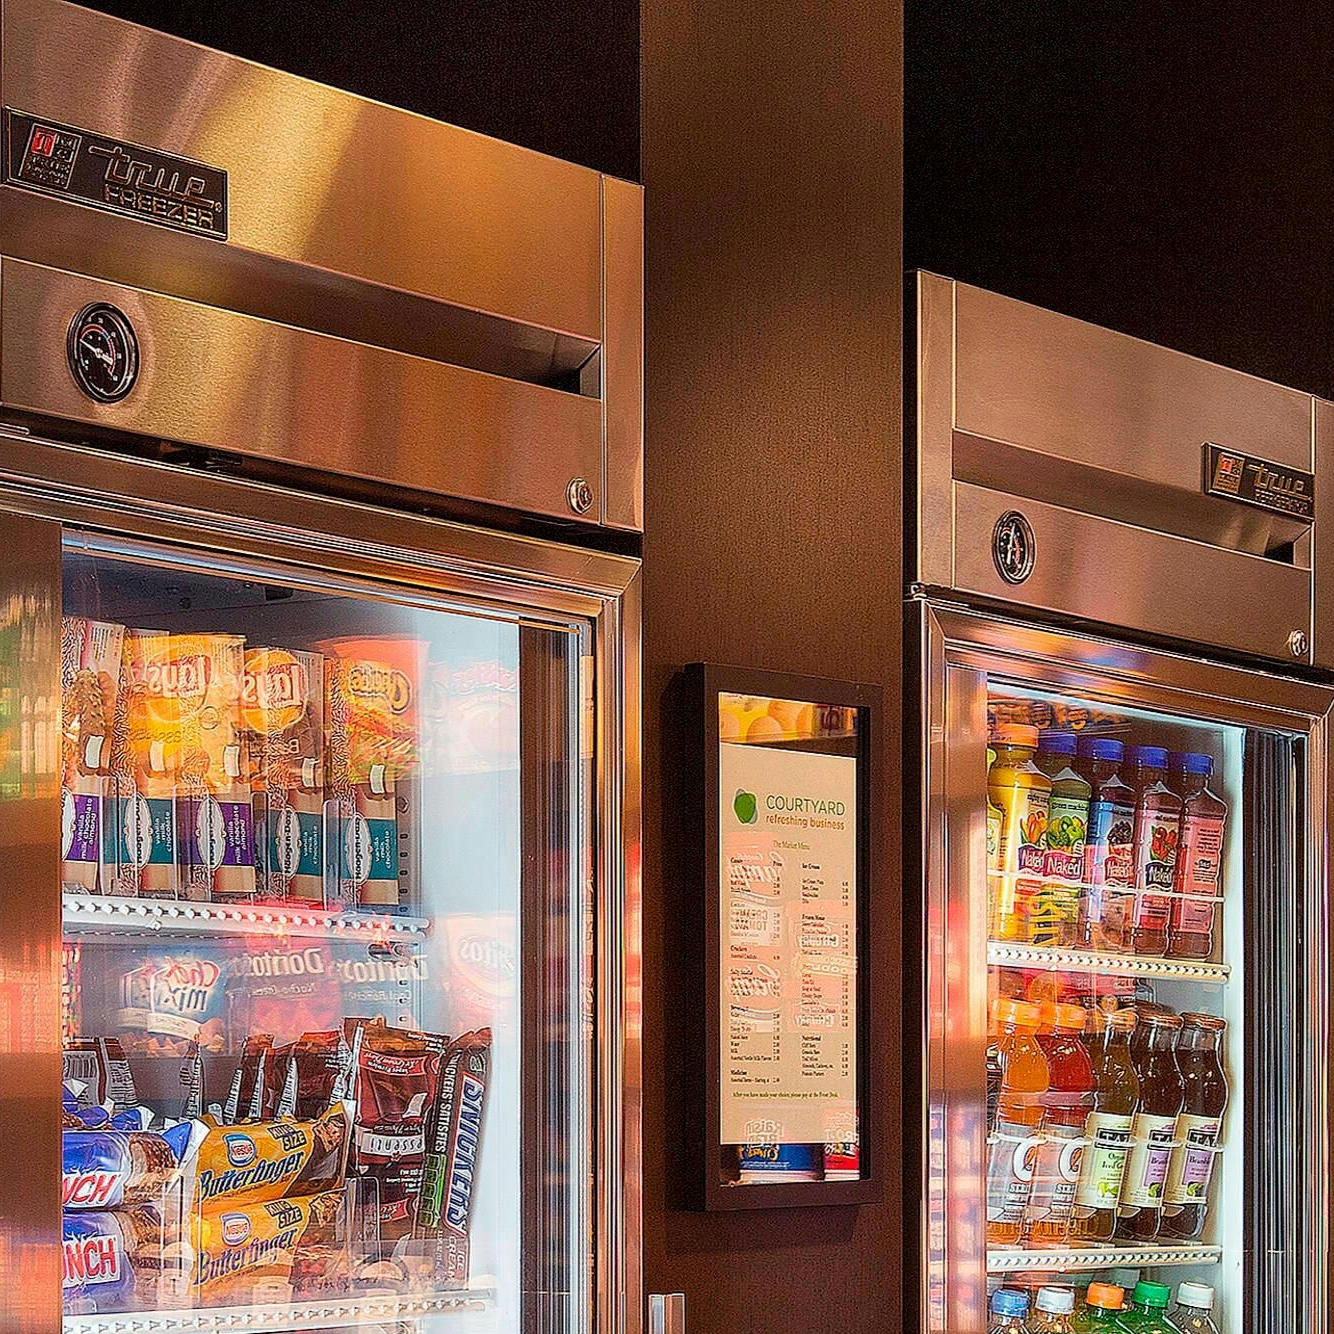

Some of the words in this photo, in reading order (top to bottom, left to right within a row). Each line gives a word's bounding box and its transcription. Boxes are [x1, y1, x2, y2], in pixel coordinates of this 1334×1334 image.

[104, 184, 215, 229] FREEZER
[766, 794, 845, 816] COURTYARD
[766, 813, 808, 829] refreshing
[810, 816, 845, 831] business
[1046, 856, 1082, 876] Naked
[1148, 864, 1173, 884] Naked
[282, 1131, 307, 1151] SIZE
[444, 1076, 484, 1234] SNICKERS
[199, 1151, 304, 1201] Butterfinger
[278, 1207, 303, 1228] SIZE
[193, 1228, 298, 1286] Butterfinger
